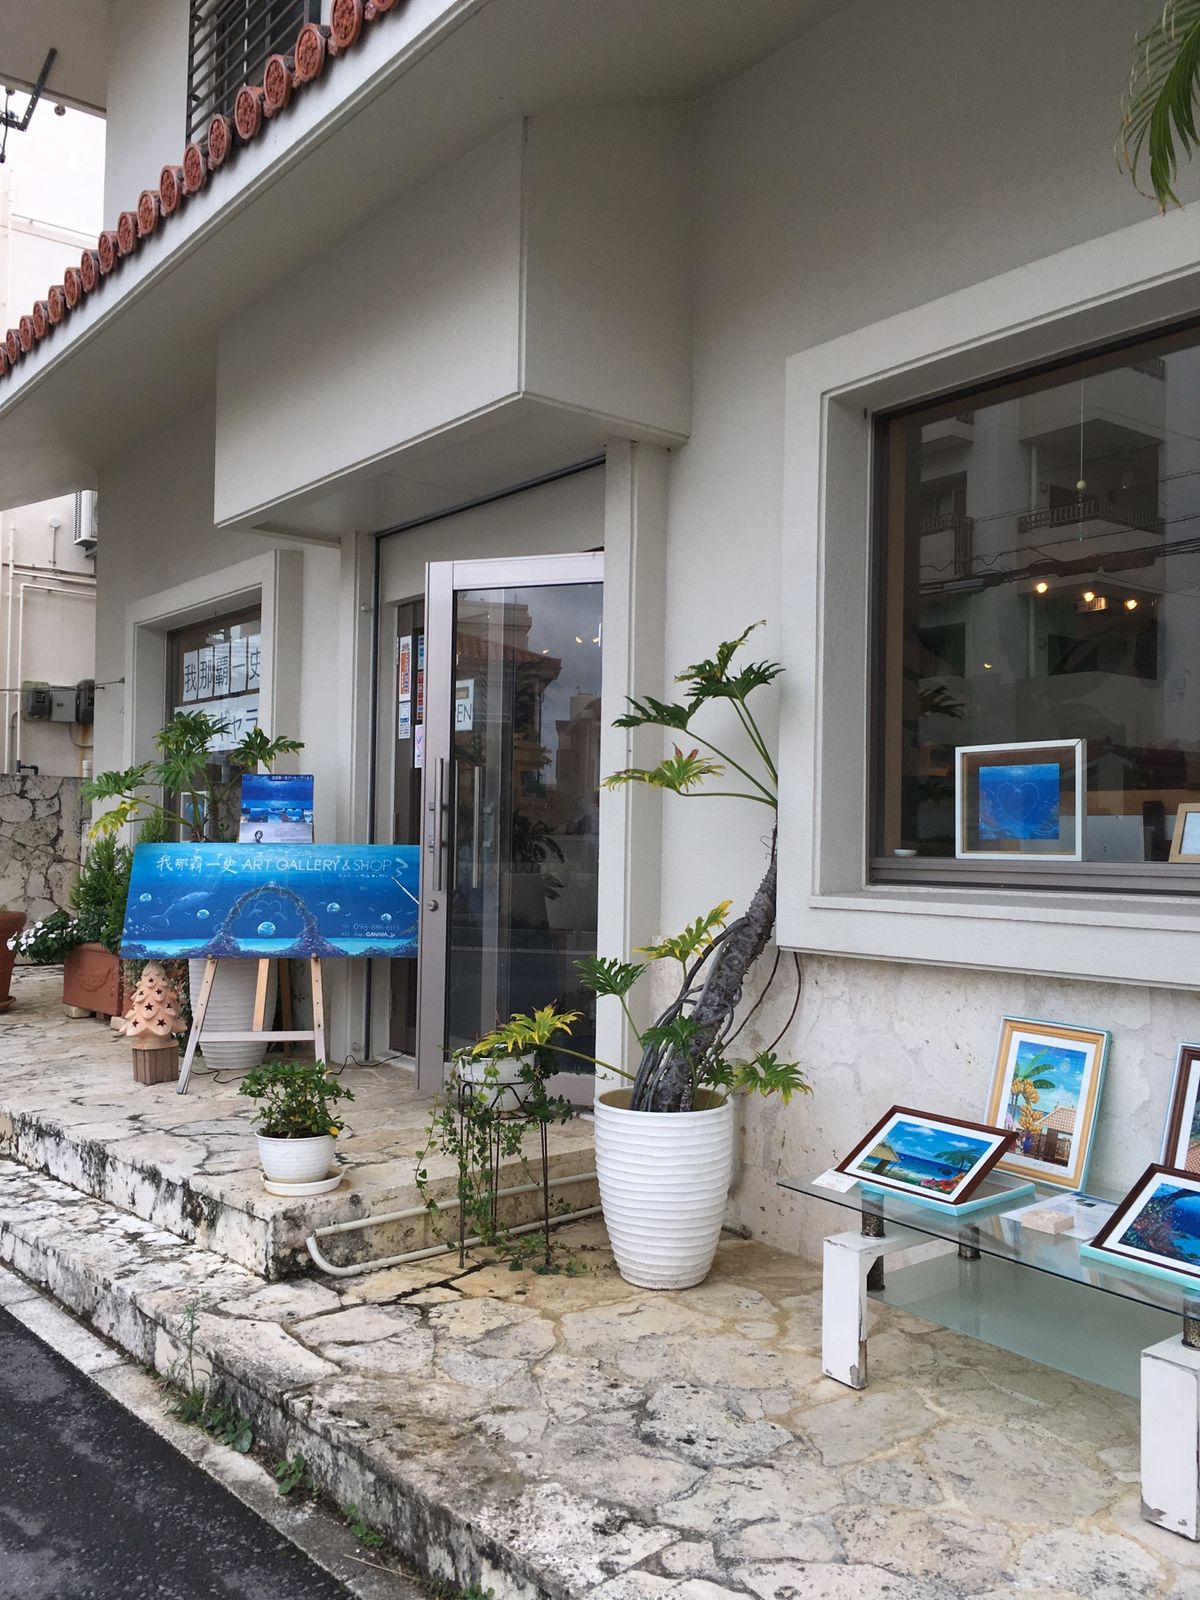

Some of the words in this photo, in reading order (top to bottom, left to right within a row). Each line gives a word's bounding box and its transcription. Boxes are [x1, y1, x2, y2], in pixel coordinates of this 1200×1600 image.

[184, 647, 260, 693] 我那覇一史
[457, 703, 472, 722] EN
[242, 858, 270, 871] ART
[275, 859, 340, 871] GALLERY
[353, 859, 392, 872] SHOP
